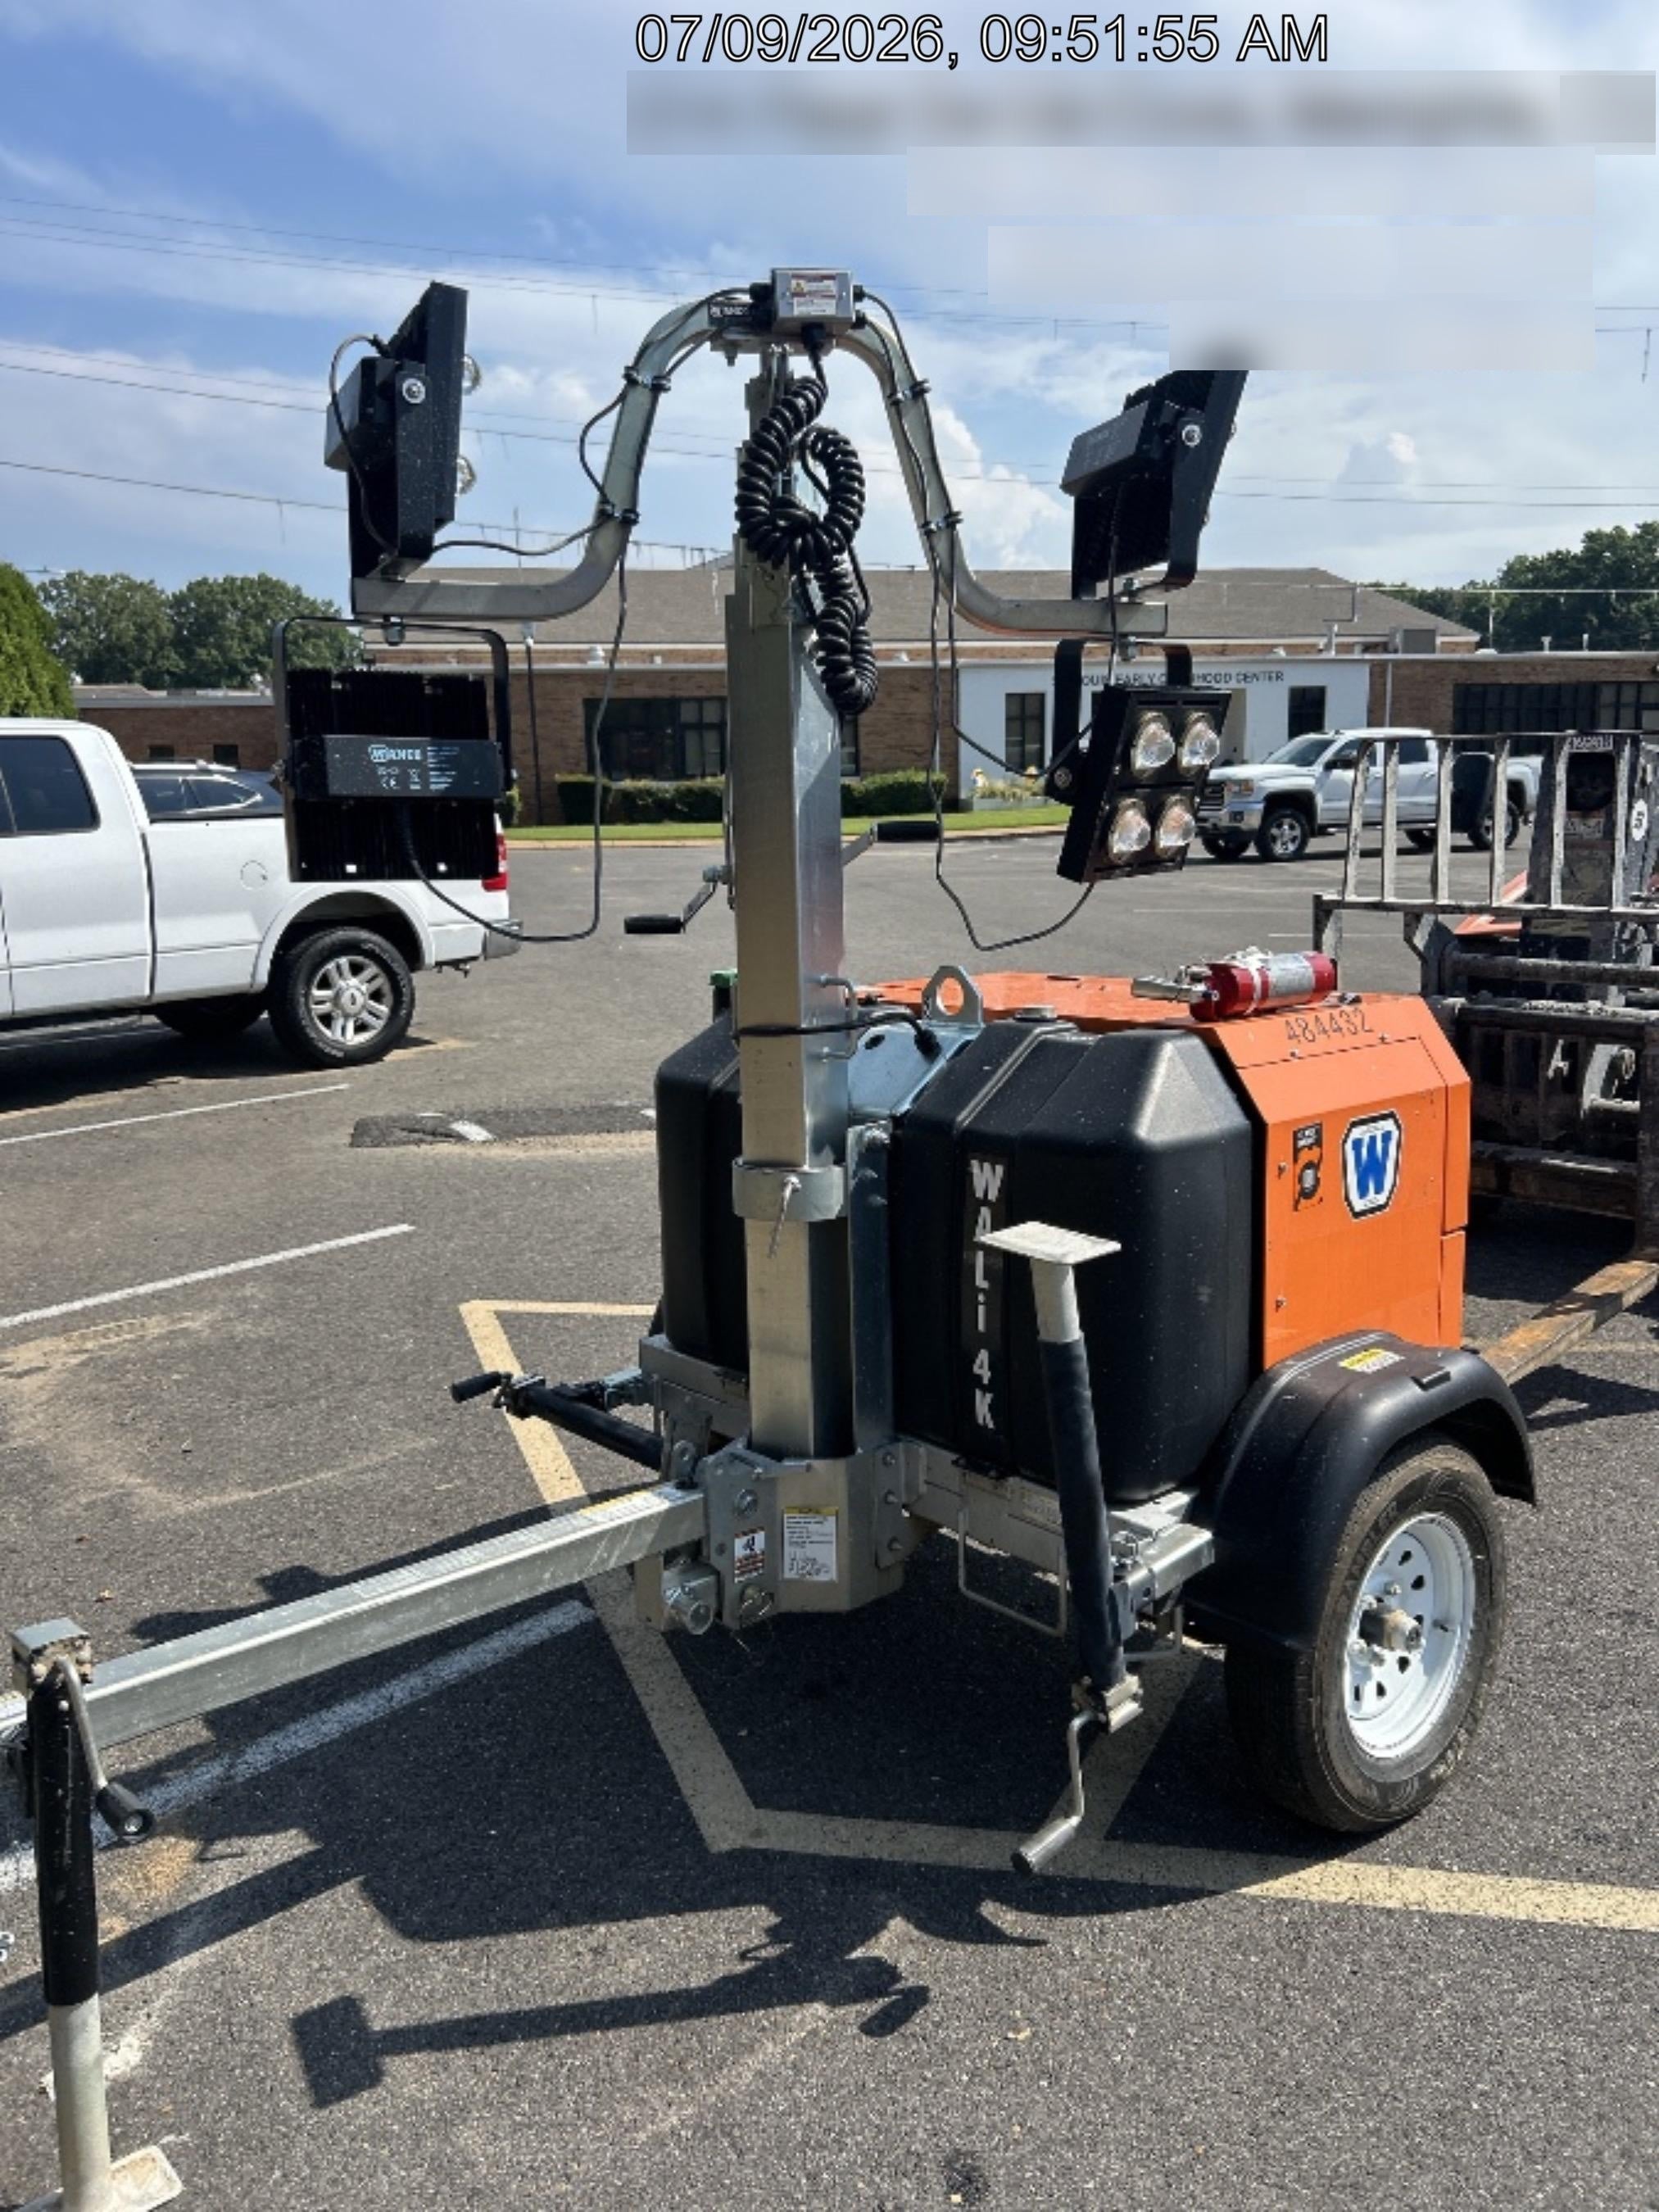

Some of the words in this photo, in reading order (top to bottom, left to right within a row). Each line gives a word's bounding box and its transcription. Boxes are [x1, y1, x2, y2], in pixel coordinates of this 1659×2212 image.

[1235, 670, 1285, 683] CENTER
[1285, 1008, 1374, 1044] 484432
[1352, 1130, 1393, 1199] W
